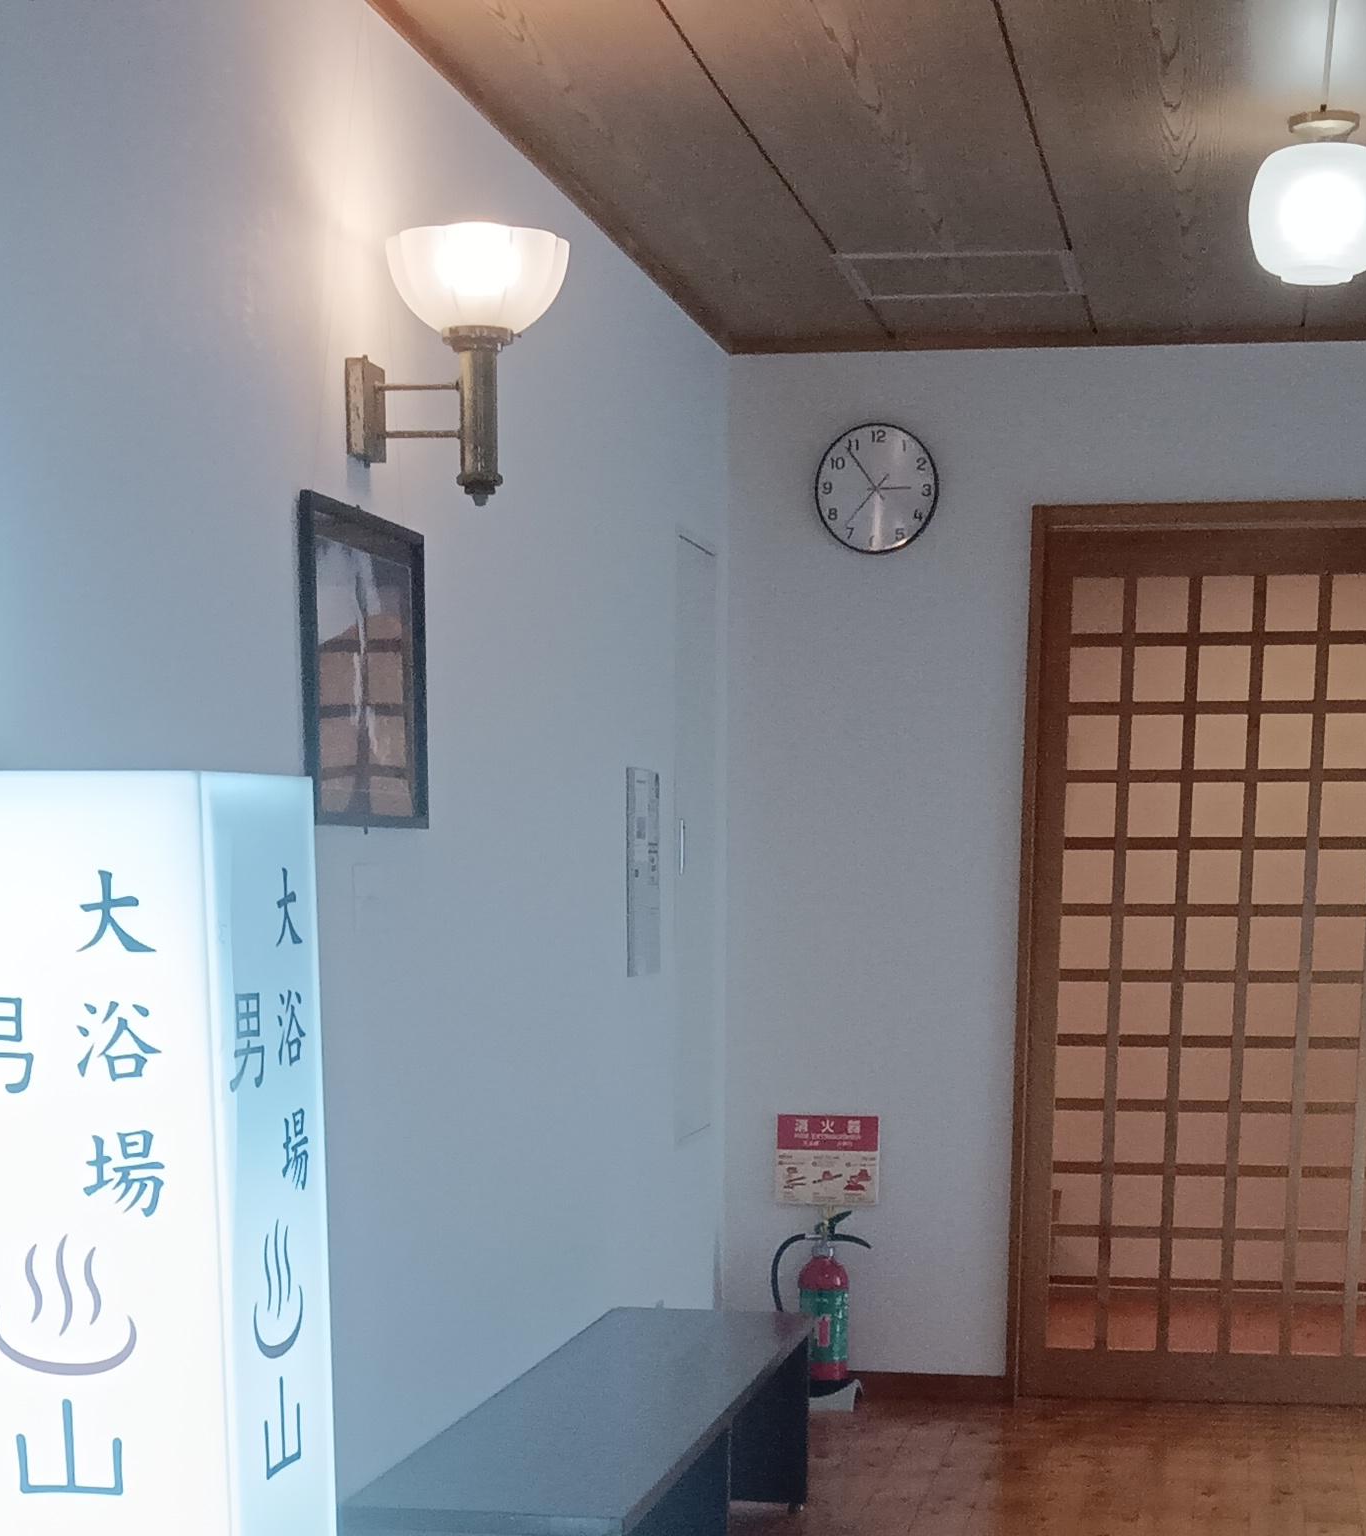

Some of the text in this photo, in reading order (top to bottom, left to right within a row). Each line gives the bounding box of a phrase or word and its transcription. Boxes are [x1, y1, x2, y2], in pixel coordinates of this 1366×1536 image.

[871, 429, 886, 443] 12
[847, 439, 860, 451] 11
[830, 457, 846, 470] 10
[916, 457, 928, 471] 2
[822, 481, 833, 495] 9
[921, 484, 932, 497] 3
[827, 508, 838, 520] 8
[913, 508, 923, 521] 4
[846, 527, 854, 539] 7
[895, 528, 905, 540] 5
[275, 866, 309, 1192] 大浴場
[75, 869, 165, 1218] 大浴場
[230, 991, 265, 1094] 男
